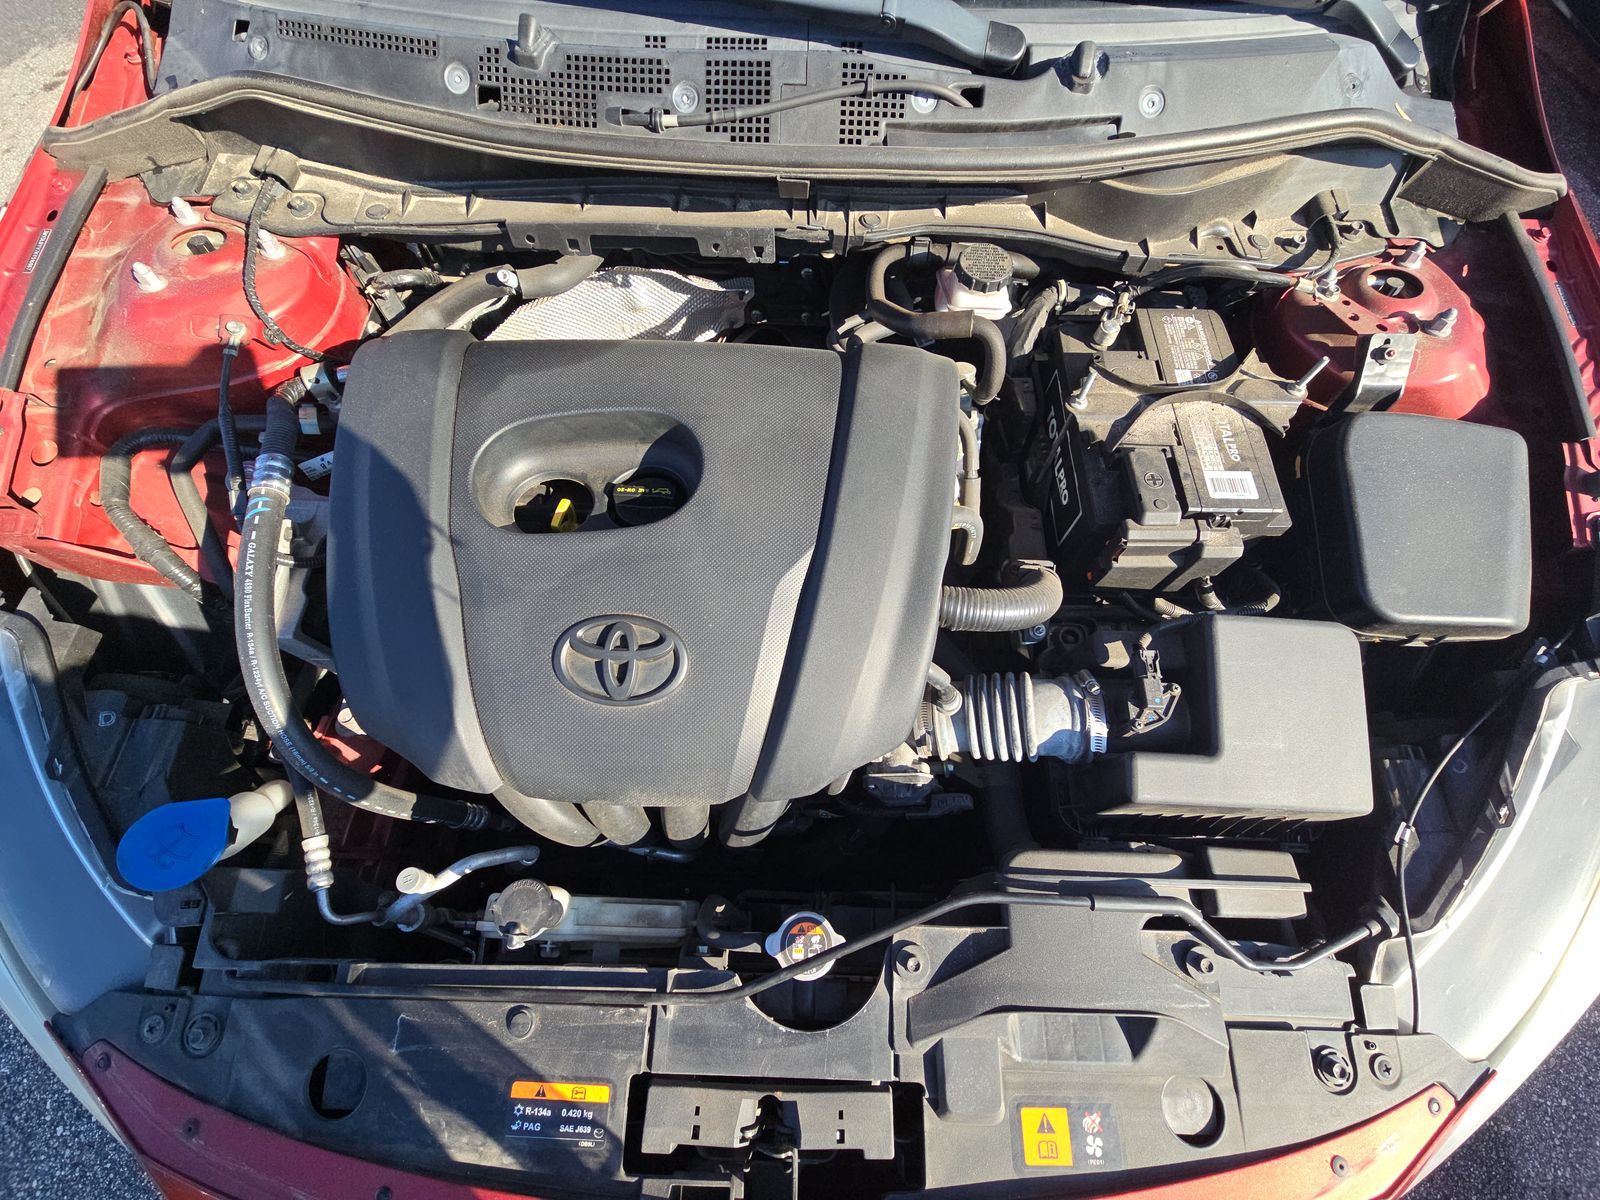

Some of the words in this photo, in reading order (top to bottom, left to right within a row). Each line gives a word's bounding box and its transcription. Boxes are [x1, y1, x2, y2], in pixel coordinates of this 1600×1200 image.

[245, 542, 256, 578] GALAXY
[247, 632, 255, 656] R-134a
[263, 700, 281, 730] SUCTION
[278, 729, 293, 748] HOSE
[525, 1107, 552, 1117] R-134a
[561, 1108, 582, 1118] 0.420
[583, 1109, 593, 1120] kg
[523, 1122, 541, 1132] PAG
[559, 1124, 574, 1133] SAE
[575, 1125, 592, 1134] J639
